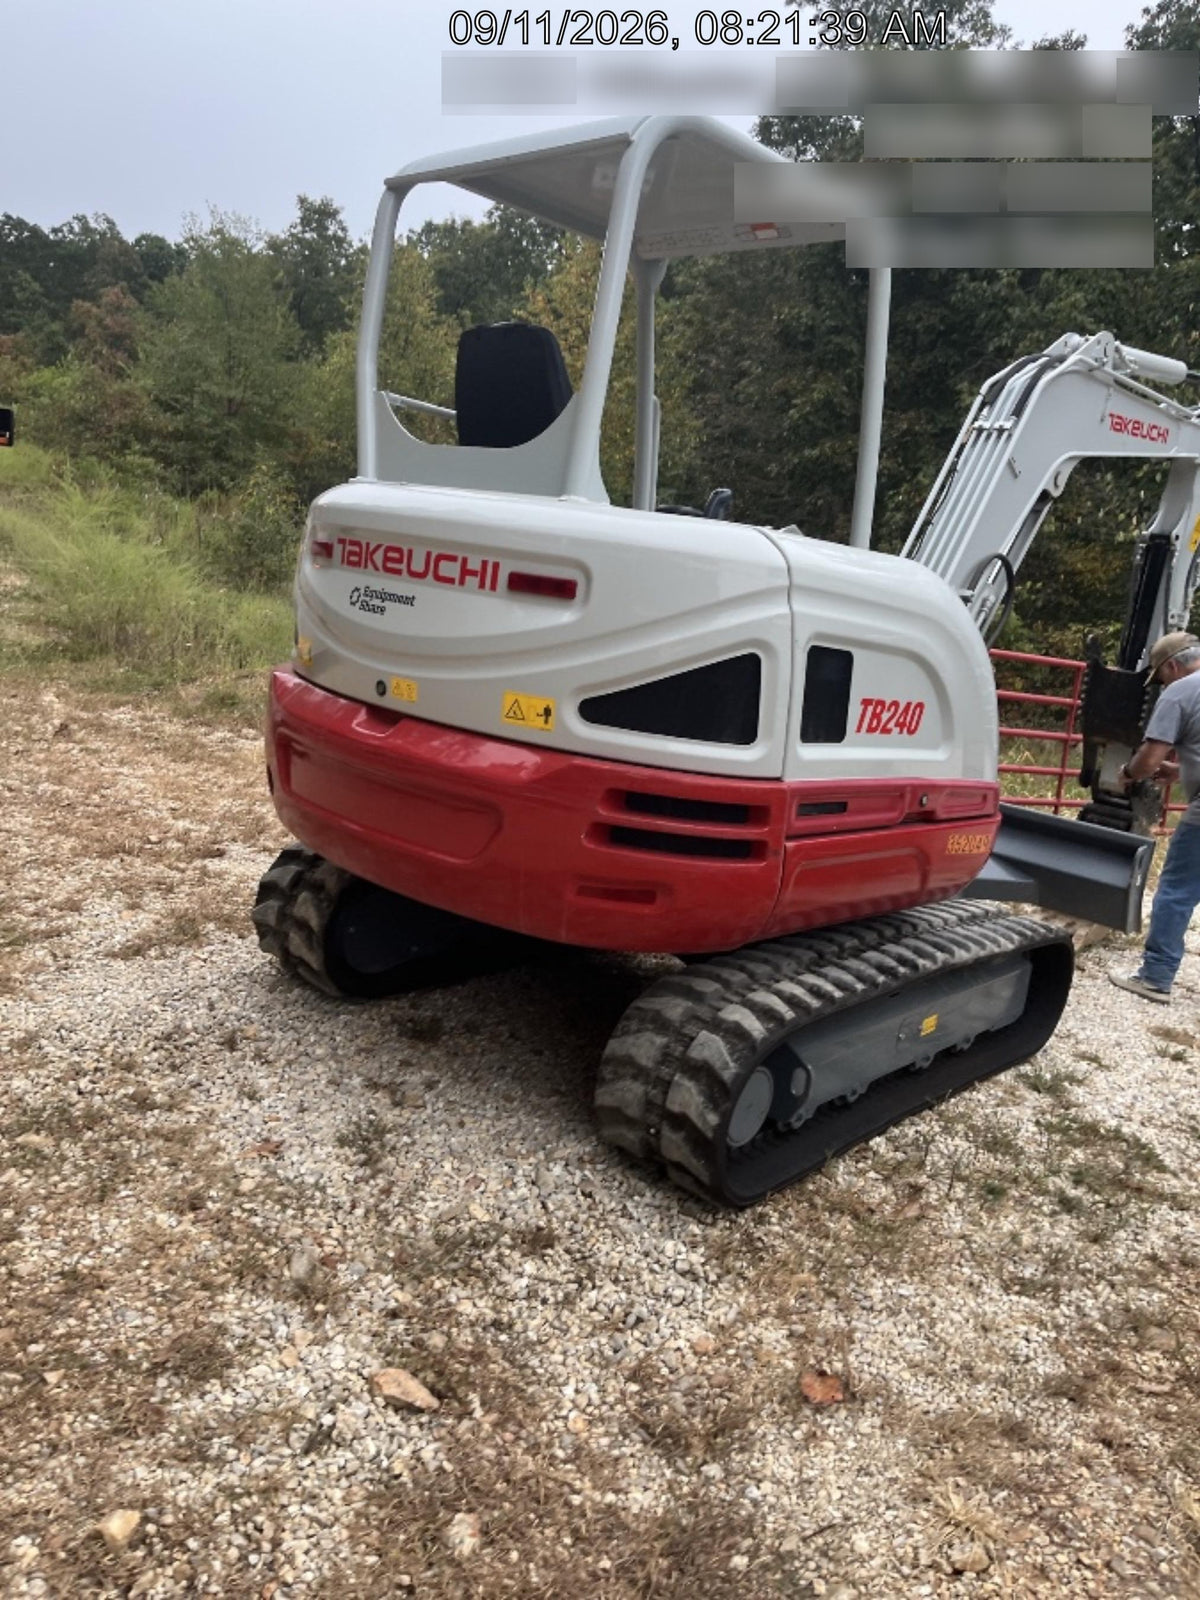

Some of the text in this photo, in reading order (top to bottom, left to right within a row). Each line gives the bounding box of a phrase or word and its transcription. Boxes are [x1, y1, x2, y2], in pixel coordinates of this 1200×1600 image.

[362, 586, 416, 607] Equipment
[358, 599, 386, 616] Share
[855, 698, 925, 736] TB240
